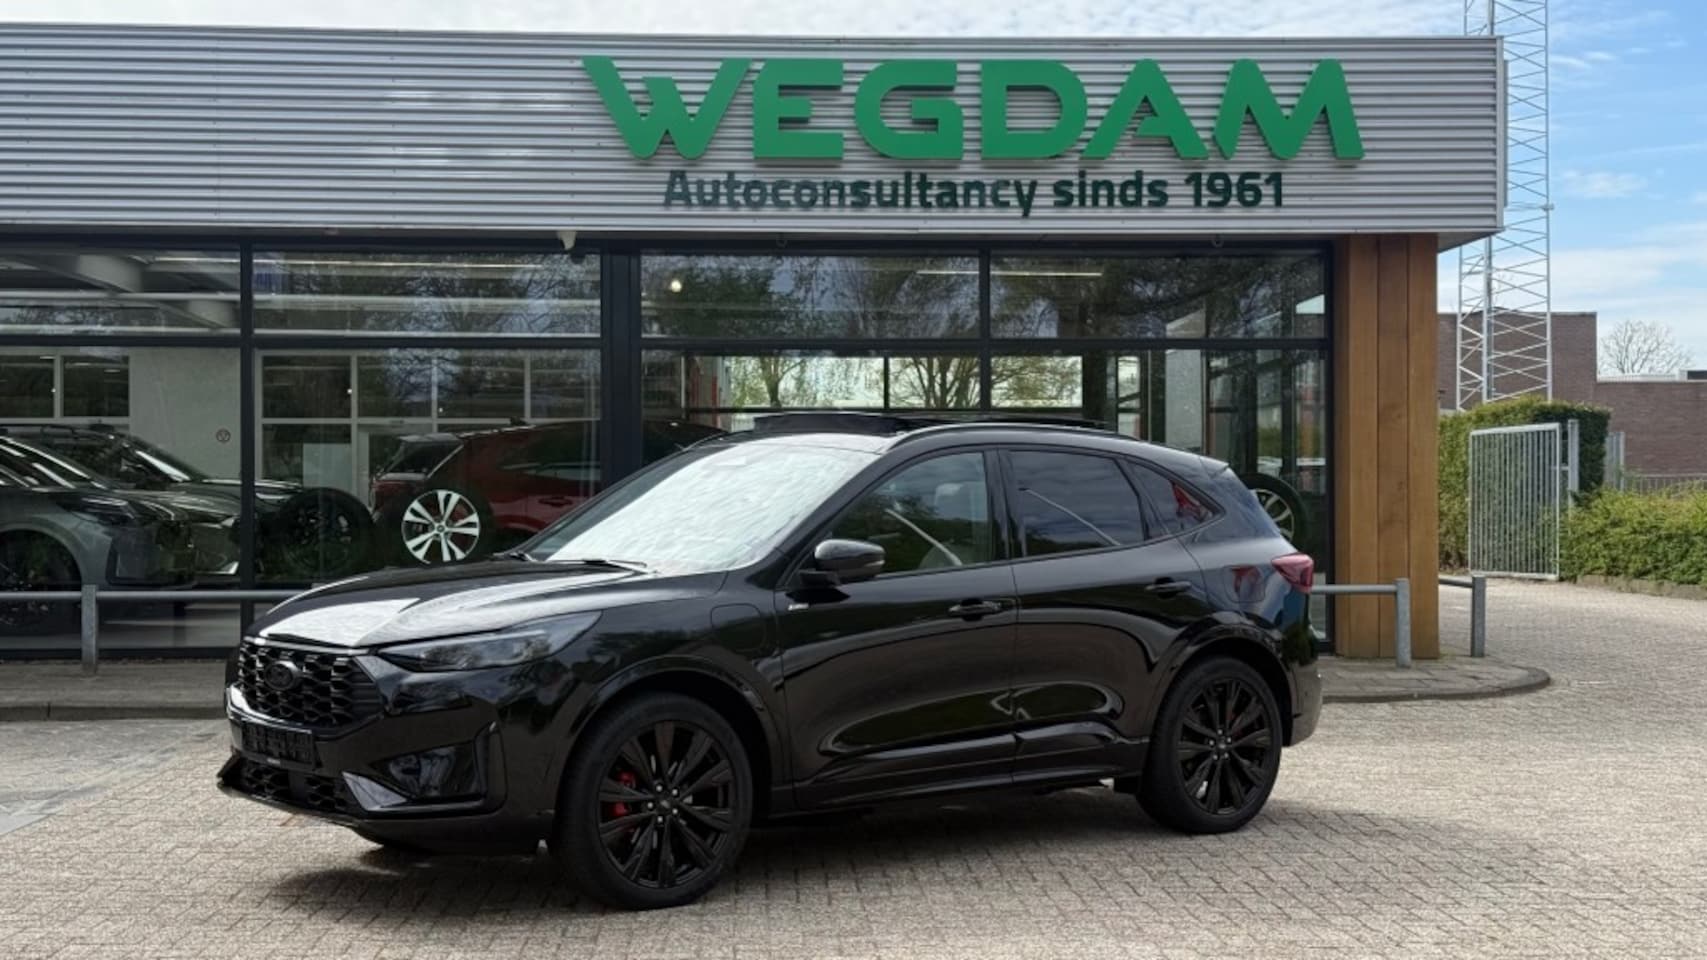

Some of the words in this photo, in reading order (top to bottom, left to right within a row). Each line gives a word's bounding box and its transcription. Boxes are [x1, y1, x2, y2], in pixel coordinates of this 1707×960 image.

[582, 55, 1365, 160] WEGDAM
[664, 170, 1037, 218] Autoconsultancy
[1053, 170, 1169, 208] sinds
[1184, 171, 1282, 208] 1961
